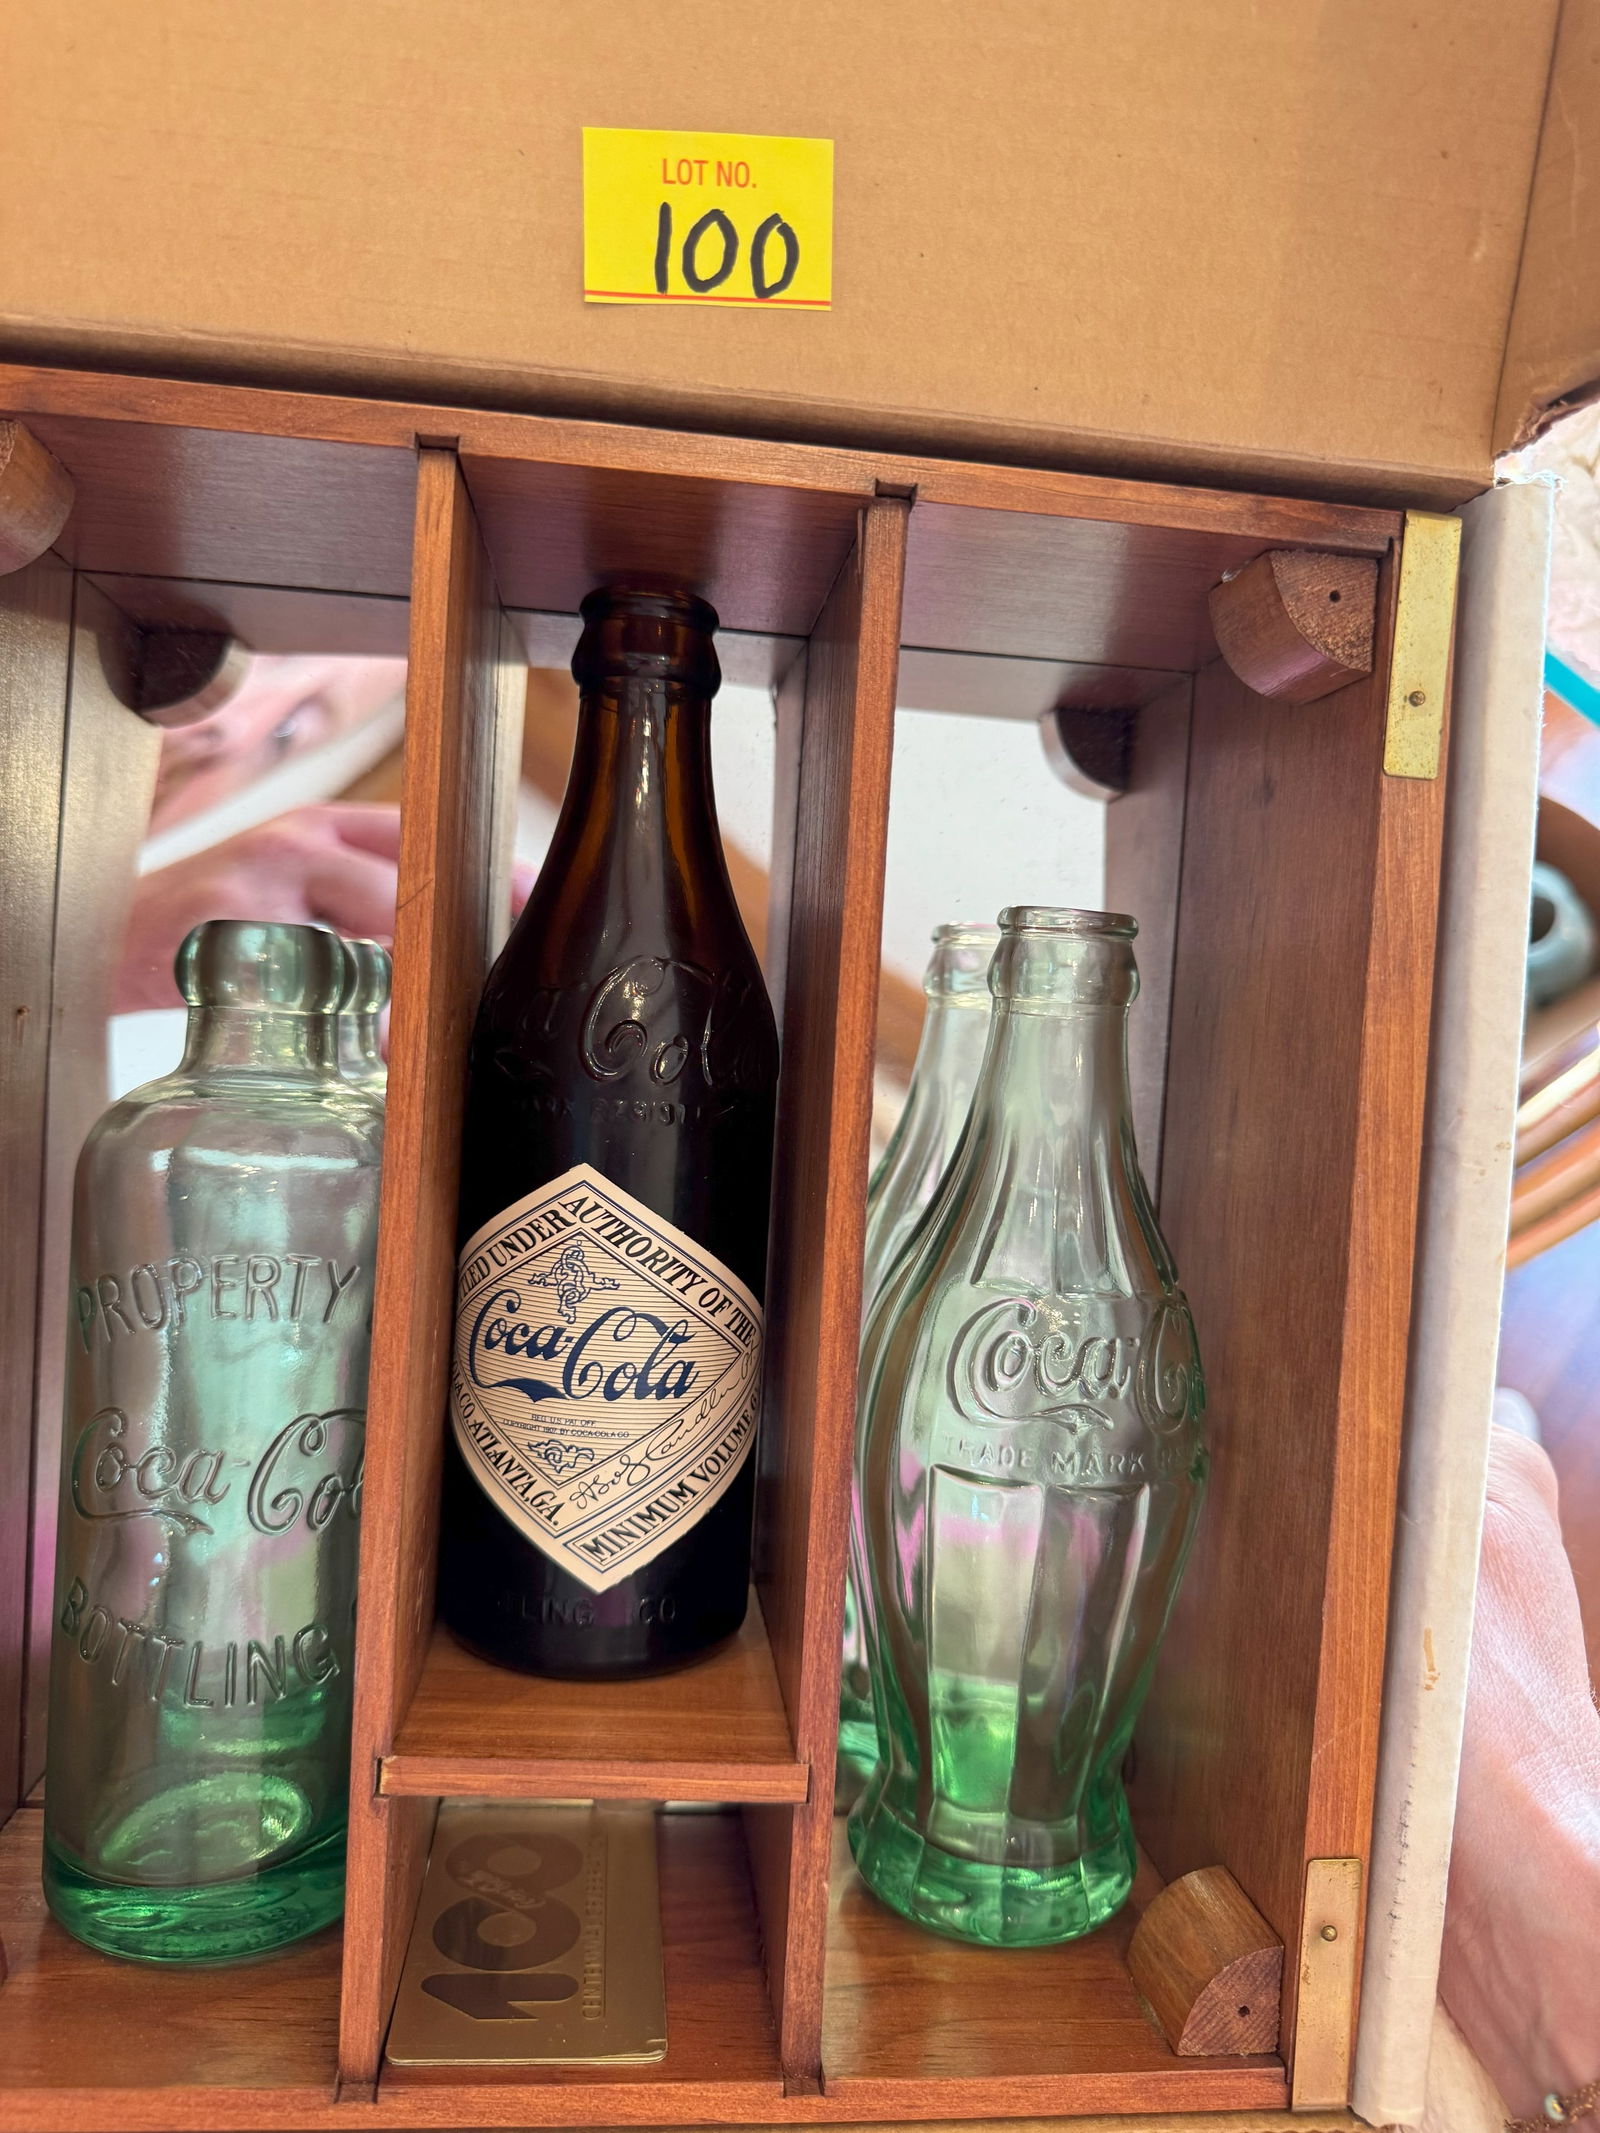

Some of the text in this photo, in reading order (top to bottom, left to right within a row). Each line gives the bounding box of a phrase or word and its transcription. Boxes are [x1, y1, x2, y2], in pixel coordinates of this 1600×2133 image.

[661, 157, 758, 189] LOT NO.
[653, 201, 801, 300] 100
[74, 1253, 361, 1354] PROPERTY
[485, 1209, 577, 1267] UNDER
[557, 1196, 709, 1296] AUTHORITY
[698, 1287, 733, 1318] OF
[724, 1306, 757, 1347] THE
[468, 1288, 701, 1404] Coca-Cola
[580, 1478, 701, 1563] MINIMUM
[688, 1410, 754, 1484] VOLUME
[1049, 1450, 1147, 1477] MARK
[60, 1575, 341, 1709] BOTTLING
